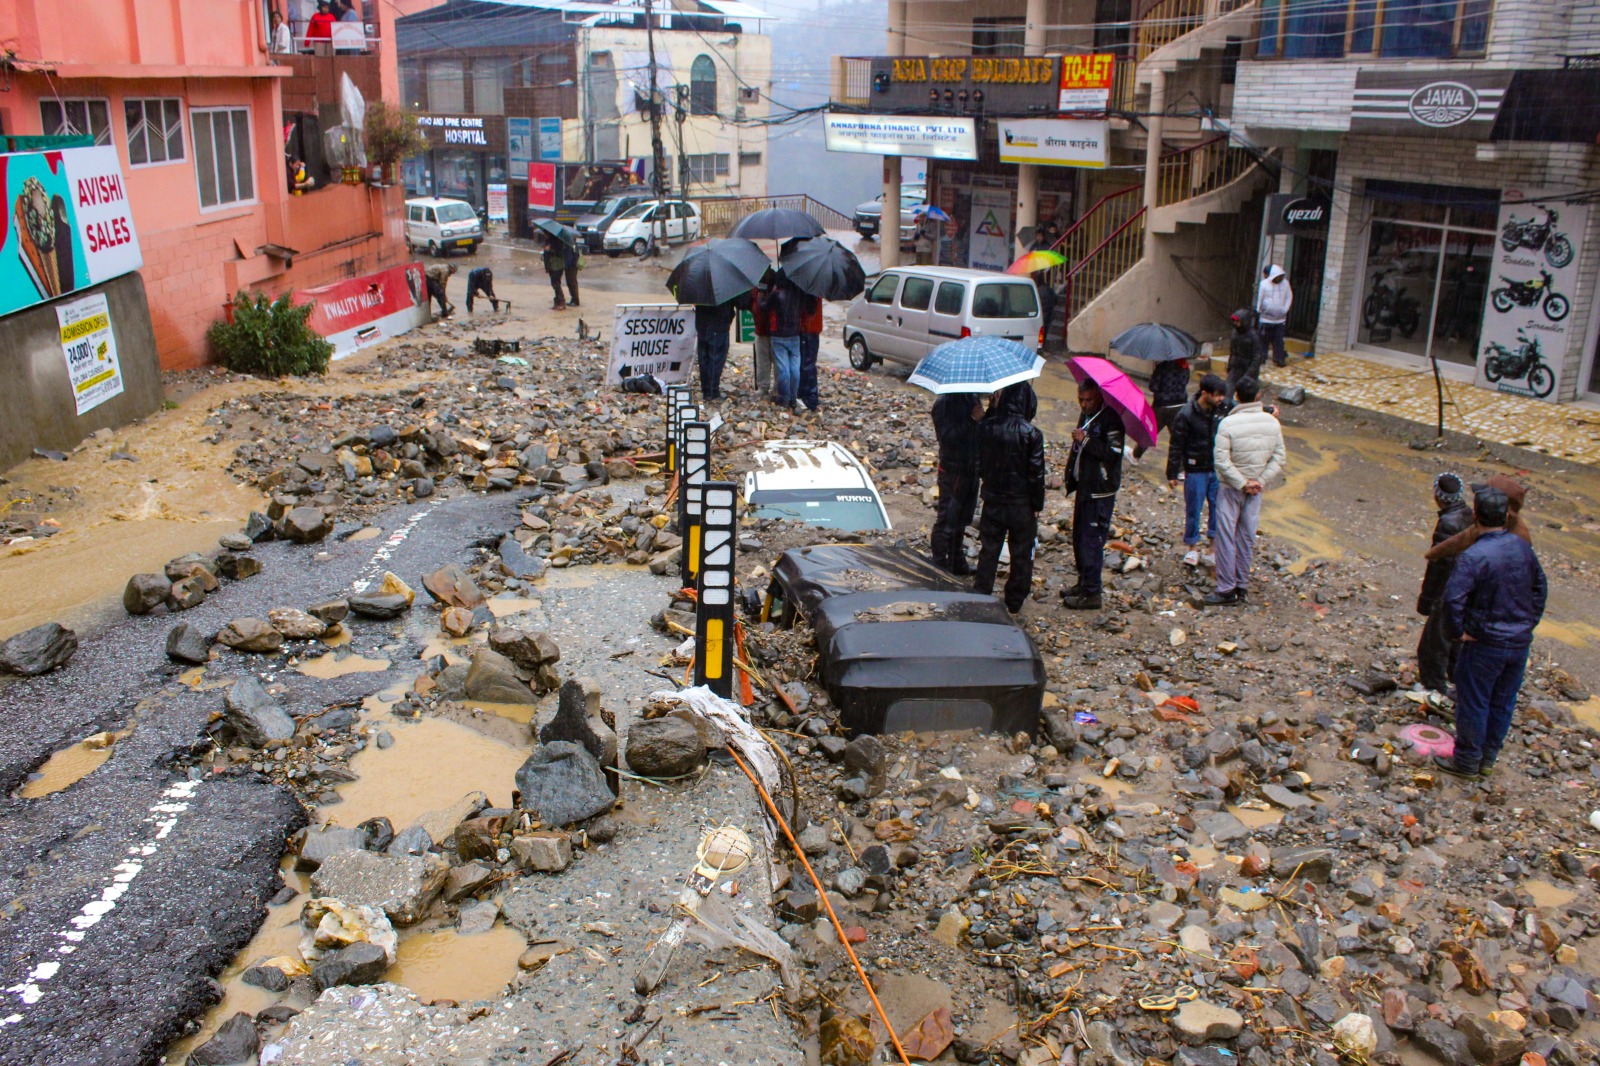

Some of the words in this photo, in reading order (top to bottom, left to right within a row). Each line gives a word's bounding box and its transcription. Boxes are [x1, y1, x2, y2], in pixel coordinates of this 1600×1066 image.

[891, 58, 927, 83] ASIA
[930, 58, 966, 83] TRIP
[970, 58, 1053, 84] HOLIDAYS
[1065, 55, 1112, 81] TO-LET
[1422, 88, 1464, 106] JAWA
[433, 117, 444, 126] AND
[445, 117, 460, 127] SPINE
[461, 118, 483, 127] CENTRE
[831, 122, 882, 130] ANNAPURNA
[884, 124, 920, 132] FINANCE
[445, 129, 487, 144] HOSPITAL
[78, 174, 123, 208] AVISHI
[1287, 205, 1323, 224] yezdi
[86, 216, 131, 253] SALES
[323, 295, 359, 320] KWALITY
[63, 321, 93, 341] ADMISSION
[625, 318, 685, 335] SESSIONS
[631, 339, 671, 357] HOUSE
